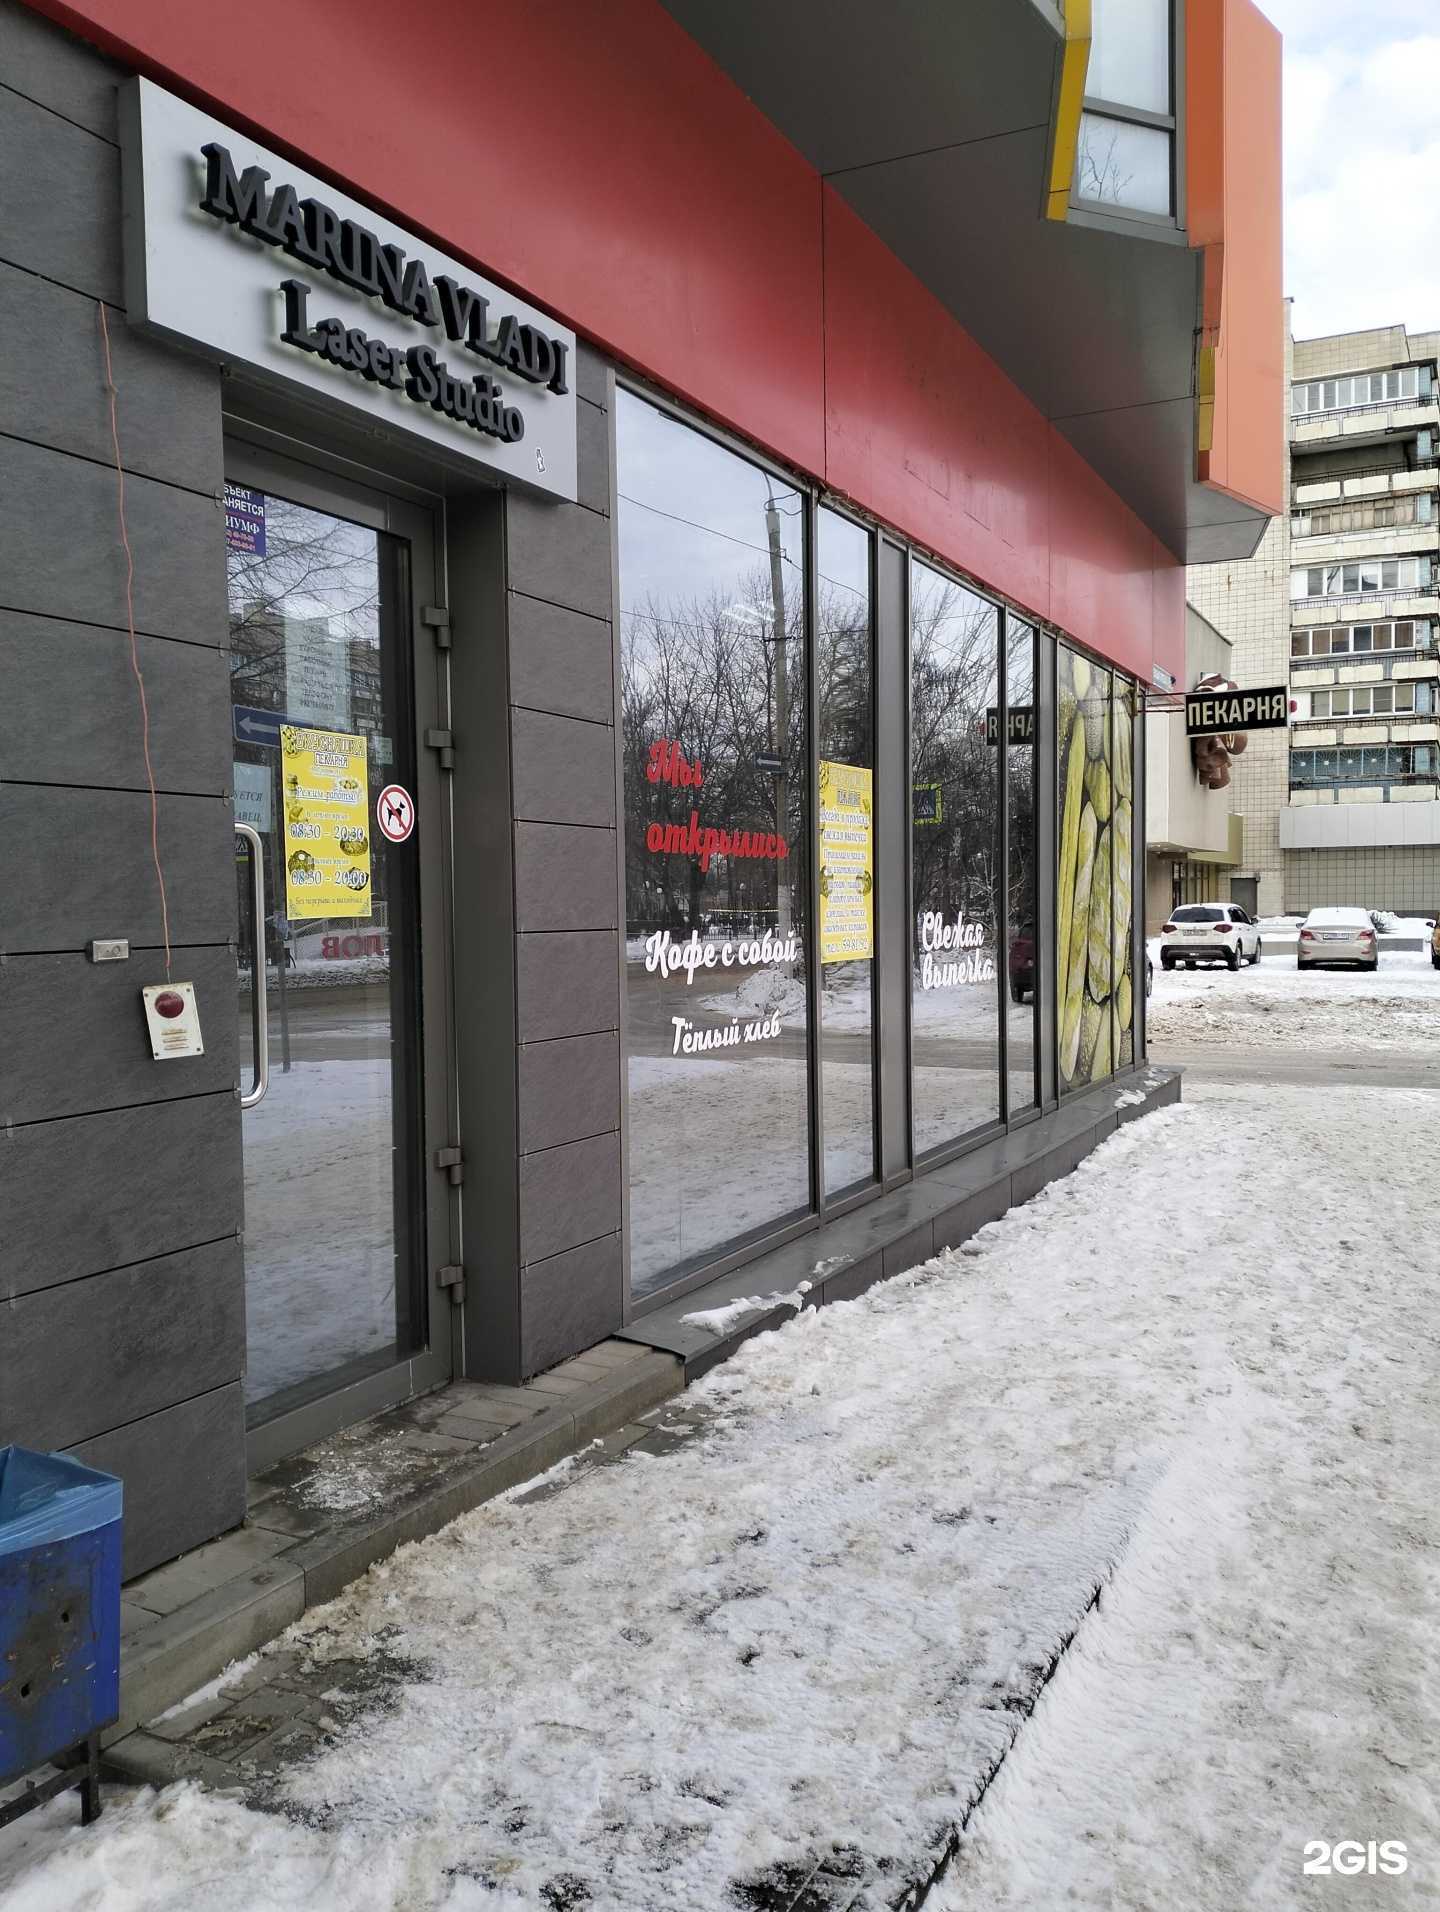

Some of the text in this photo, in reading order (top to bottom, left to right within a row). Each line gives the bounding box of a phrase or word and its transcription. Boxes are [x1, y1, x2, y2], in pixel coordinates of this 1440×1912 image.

[280, 279, 525, 443] Laser Studio
[1188, 694, 1286, 727] ПЕКАРНЯ
[646, 738, 704, 788] Мы
[646, 809, 790, 873] открылись
[645, 929, 718, 985] Кофе
[738, 928, 798, 966] собой
[922, 911, 985, 952] Свежая
[671, 1009, 782, 1056] Тёплый хлеб
